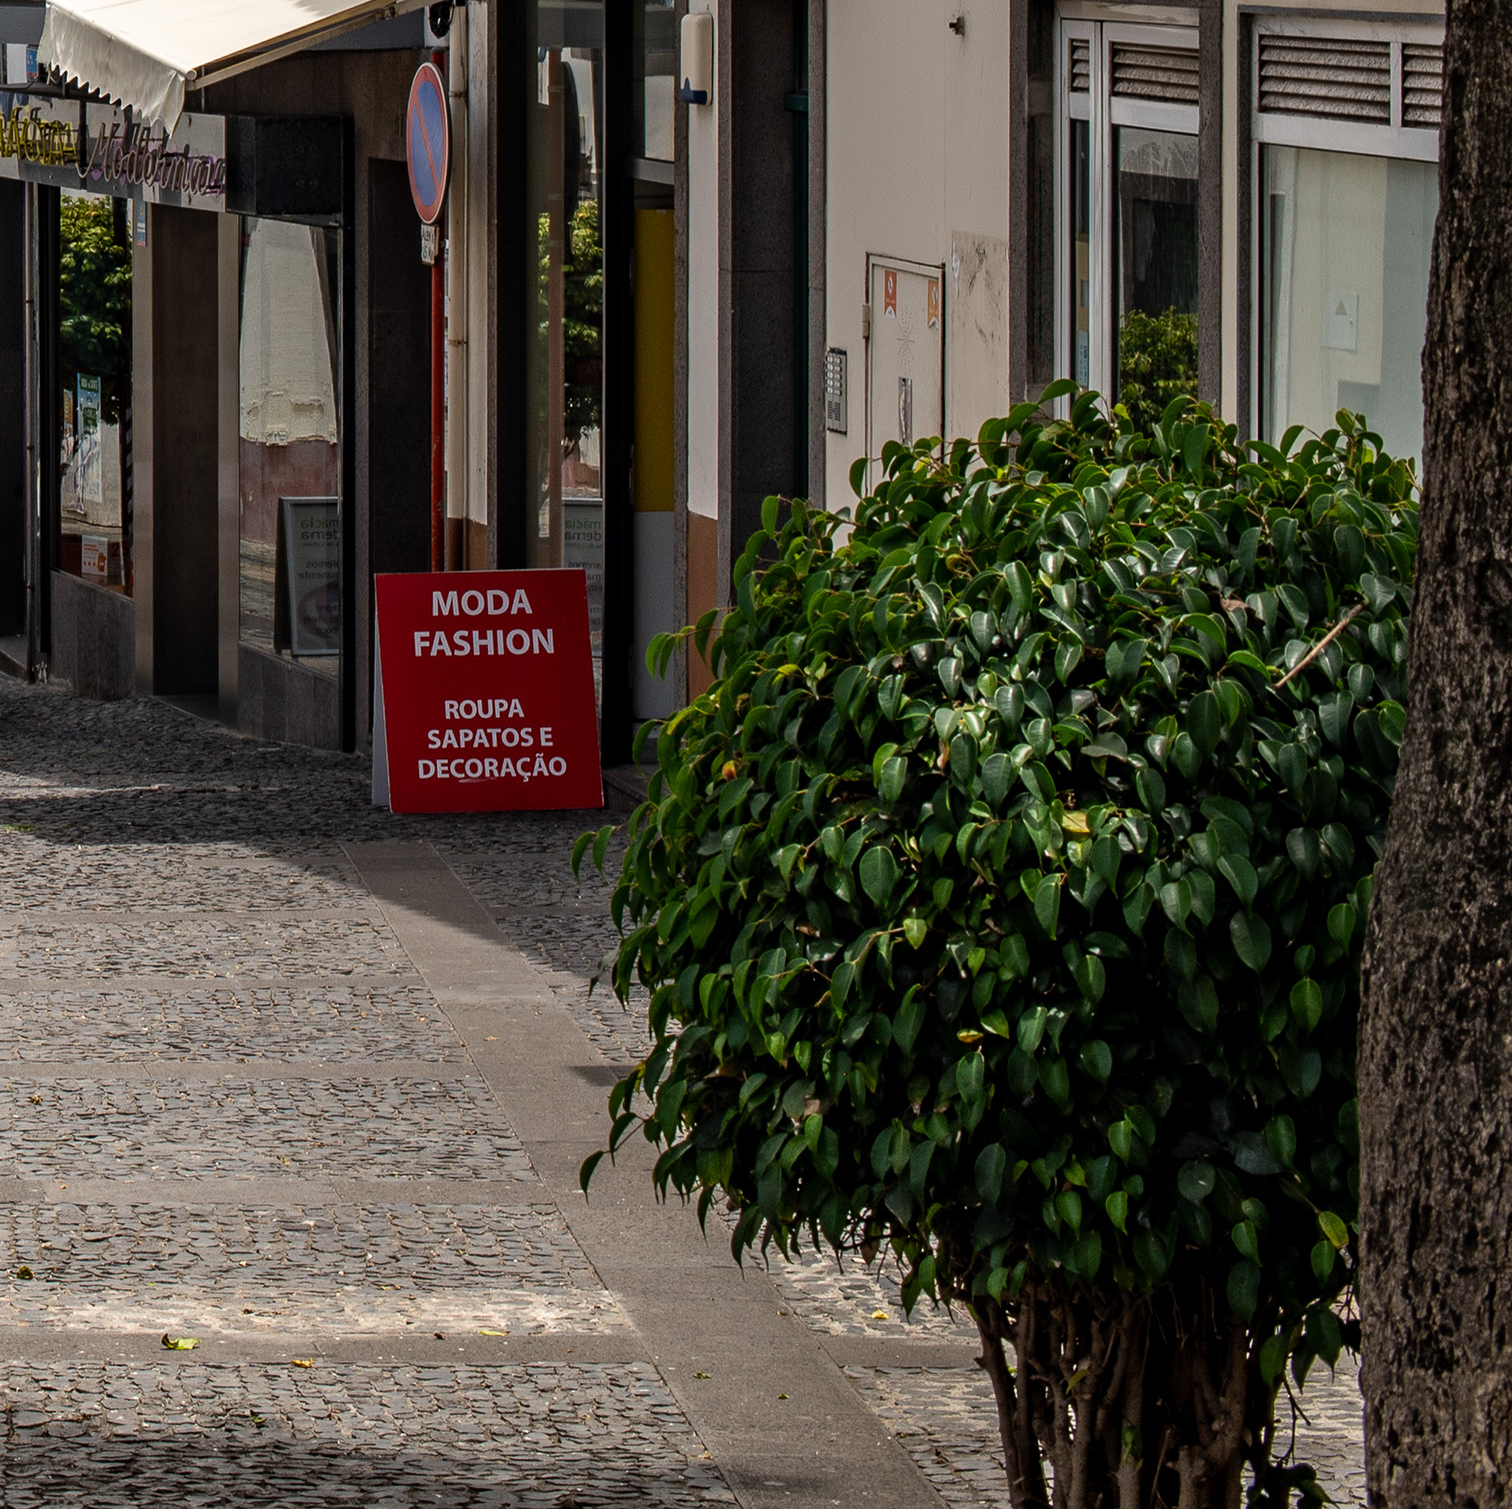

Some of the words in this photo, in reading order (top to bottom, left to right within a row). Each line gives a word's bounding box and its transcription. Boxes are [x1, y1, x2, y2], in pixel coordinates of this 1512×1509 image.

[77, 121, 224, 196] Moderna
[432, 588, 533, 617] MODA
[413, 628, 555, 657] FASHION
[444, 698, 525, 720] ROUPA
[427, 727, 534, 749] SAPATOS
[539, 727, 554, 747] E
[418, 752, 567, 783] DECORAÇÃO
